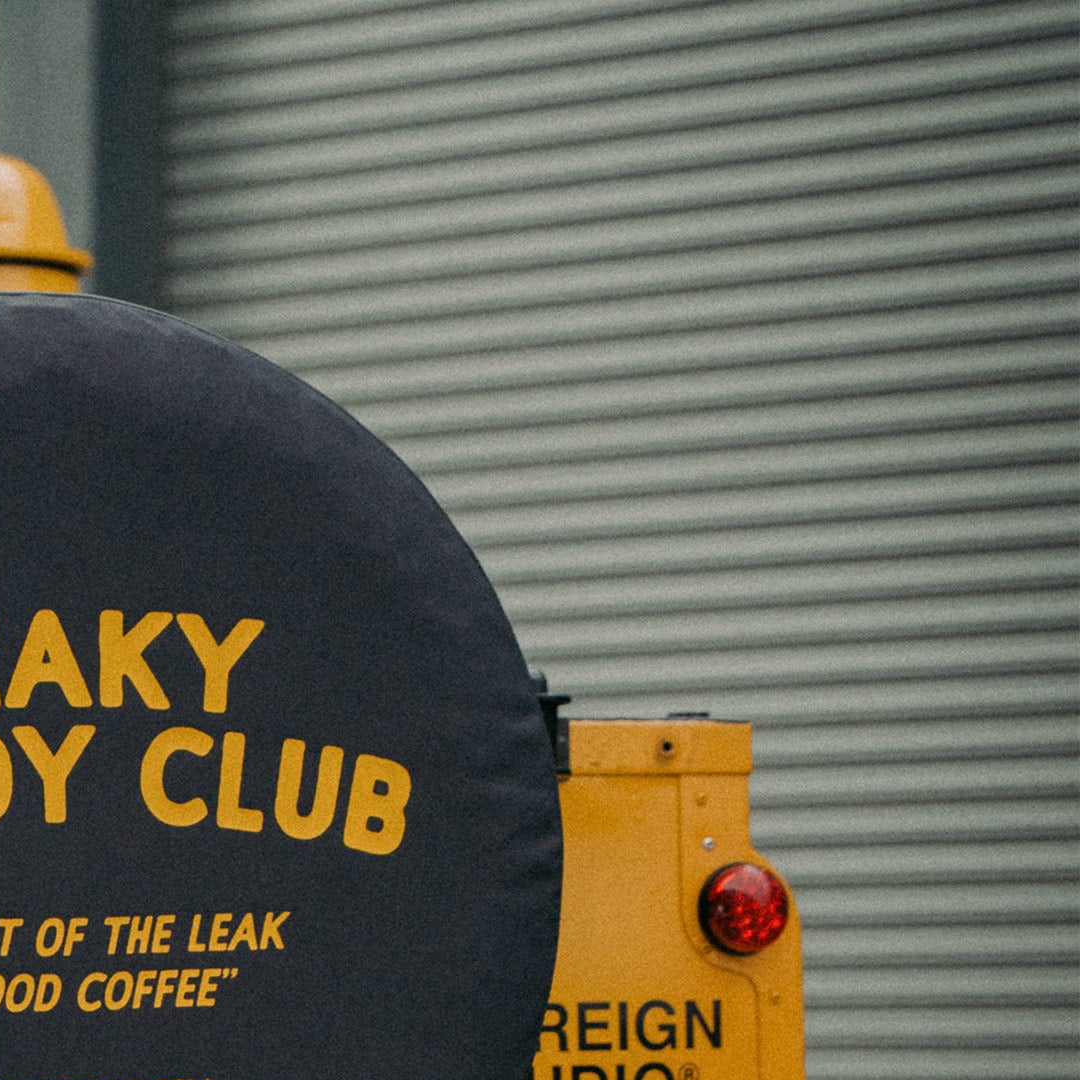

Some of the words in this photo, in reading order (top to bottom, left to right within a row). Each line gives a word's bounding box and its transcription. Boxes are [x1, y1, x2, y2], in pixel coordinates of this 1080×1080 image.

[139, 726, 412, 855] CLUB
[35, 917, 89, 957] OF
[104, 914, 176, 955] THE
[187, 911, 291, 953] LEAK
